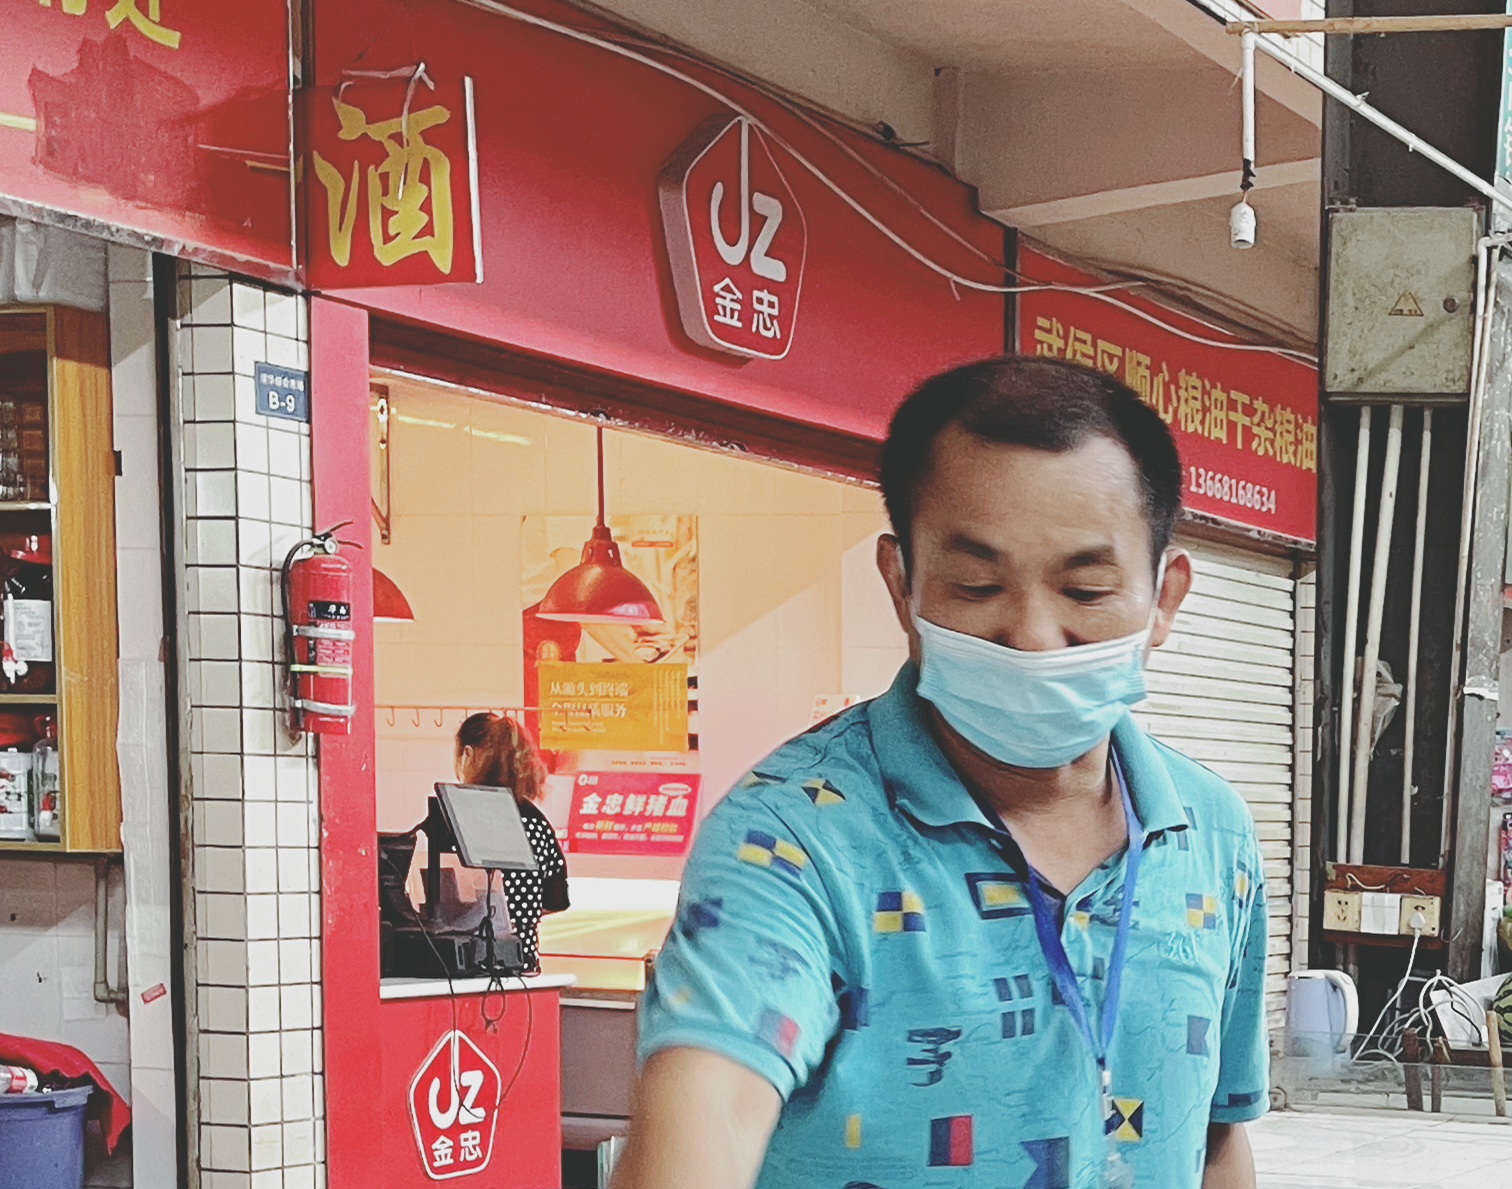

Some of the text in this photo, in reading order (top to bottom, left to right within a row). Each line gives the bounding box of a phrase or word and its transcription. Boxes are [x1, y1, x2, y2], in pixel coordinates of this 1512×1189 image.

[312, 104, 454, 275] 酒
[712, 276, 781, 340] 金忠
[268, 390, 296, 413] B-9
[1189, 466, 1276, 514] 13668168634
[431, 1129, 482, 1168] 金忠
